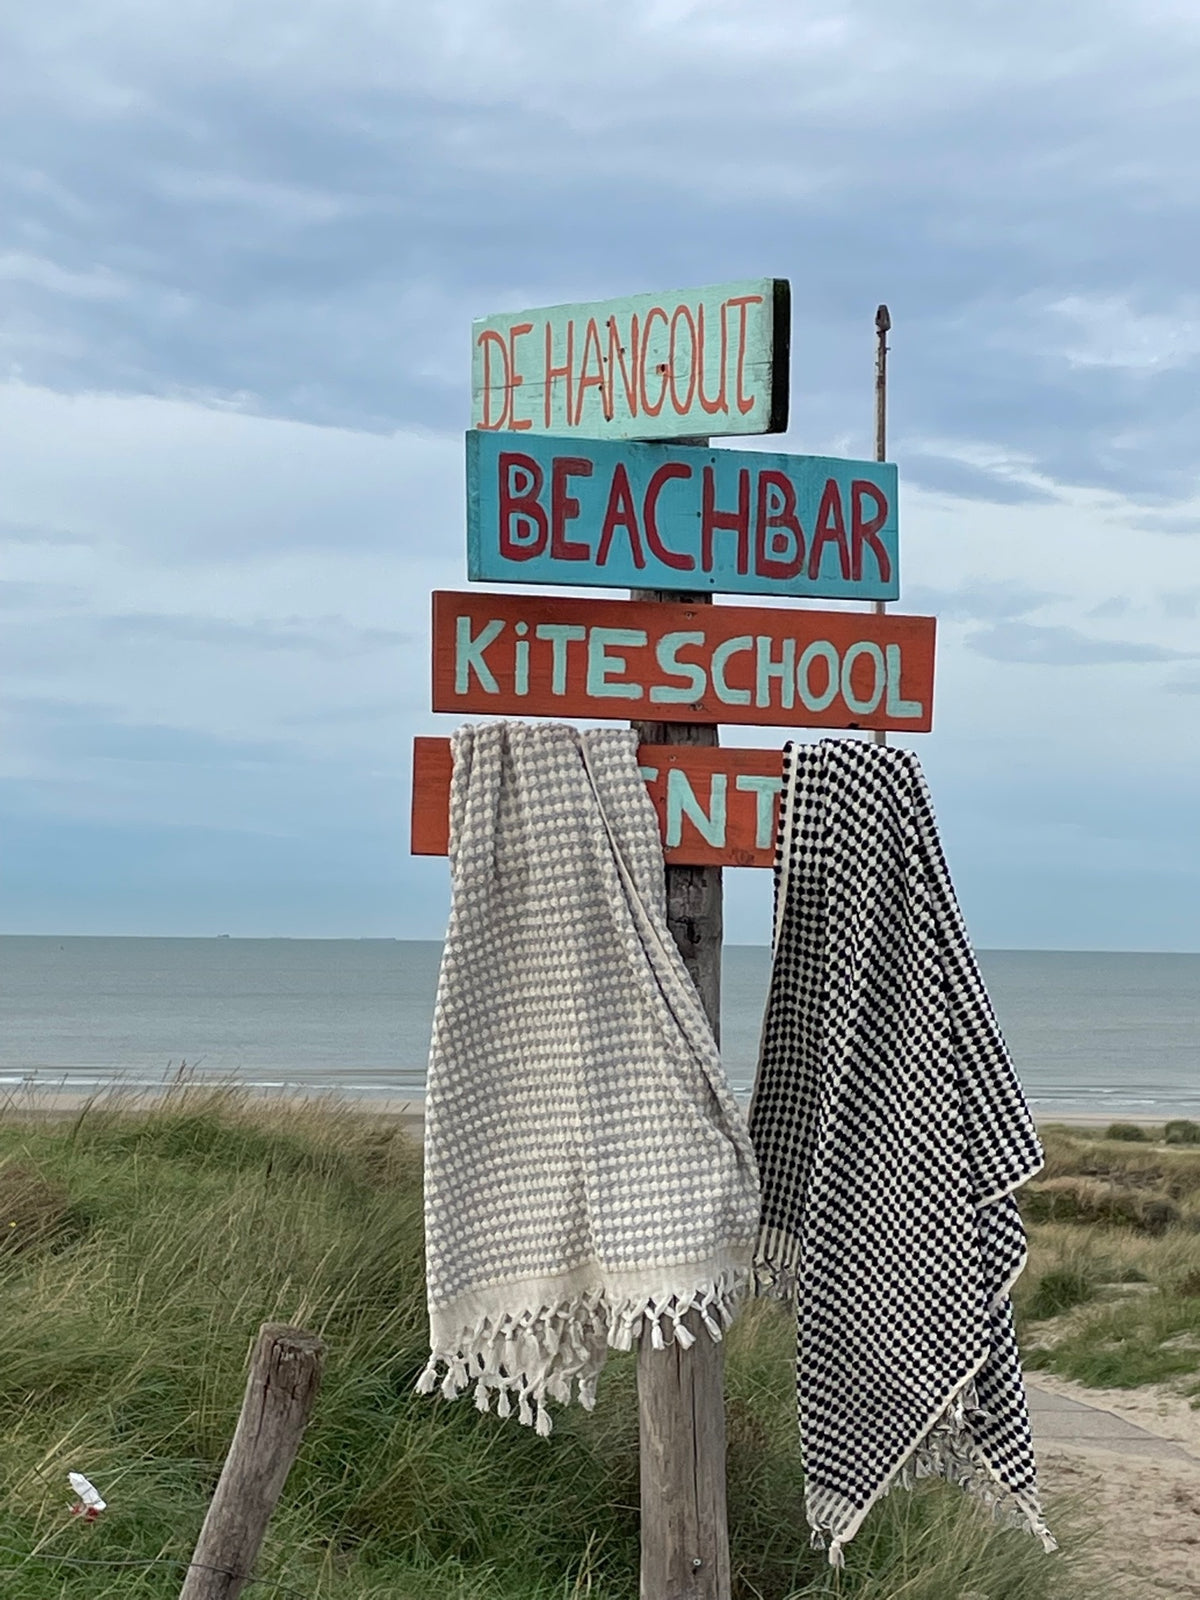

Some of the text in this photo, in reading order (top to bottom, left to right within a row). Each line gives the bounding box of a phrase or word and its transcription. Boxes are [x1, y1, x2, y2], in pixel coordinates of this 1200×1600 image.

[477, 296, 762, 430] DE HANGOUT
[499, 452, 890, 583] BEACHBAR
[640, 766, 783, 850] NT
